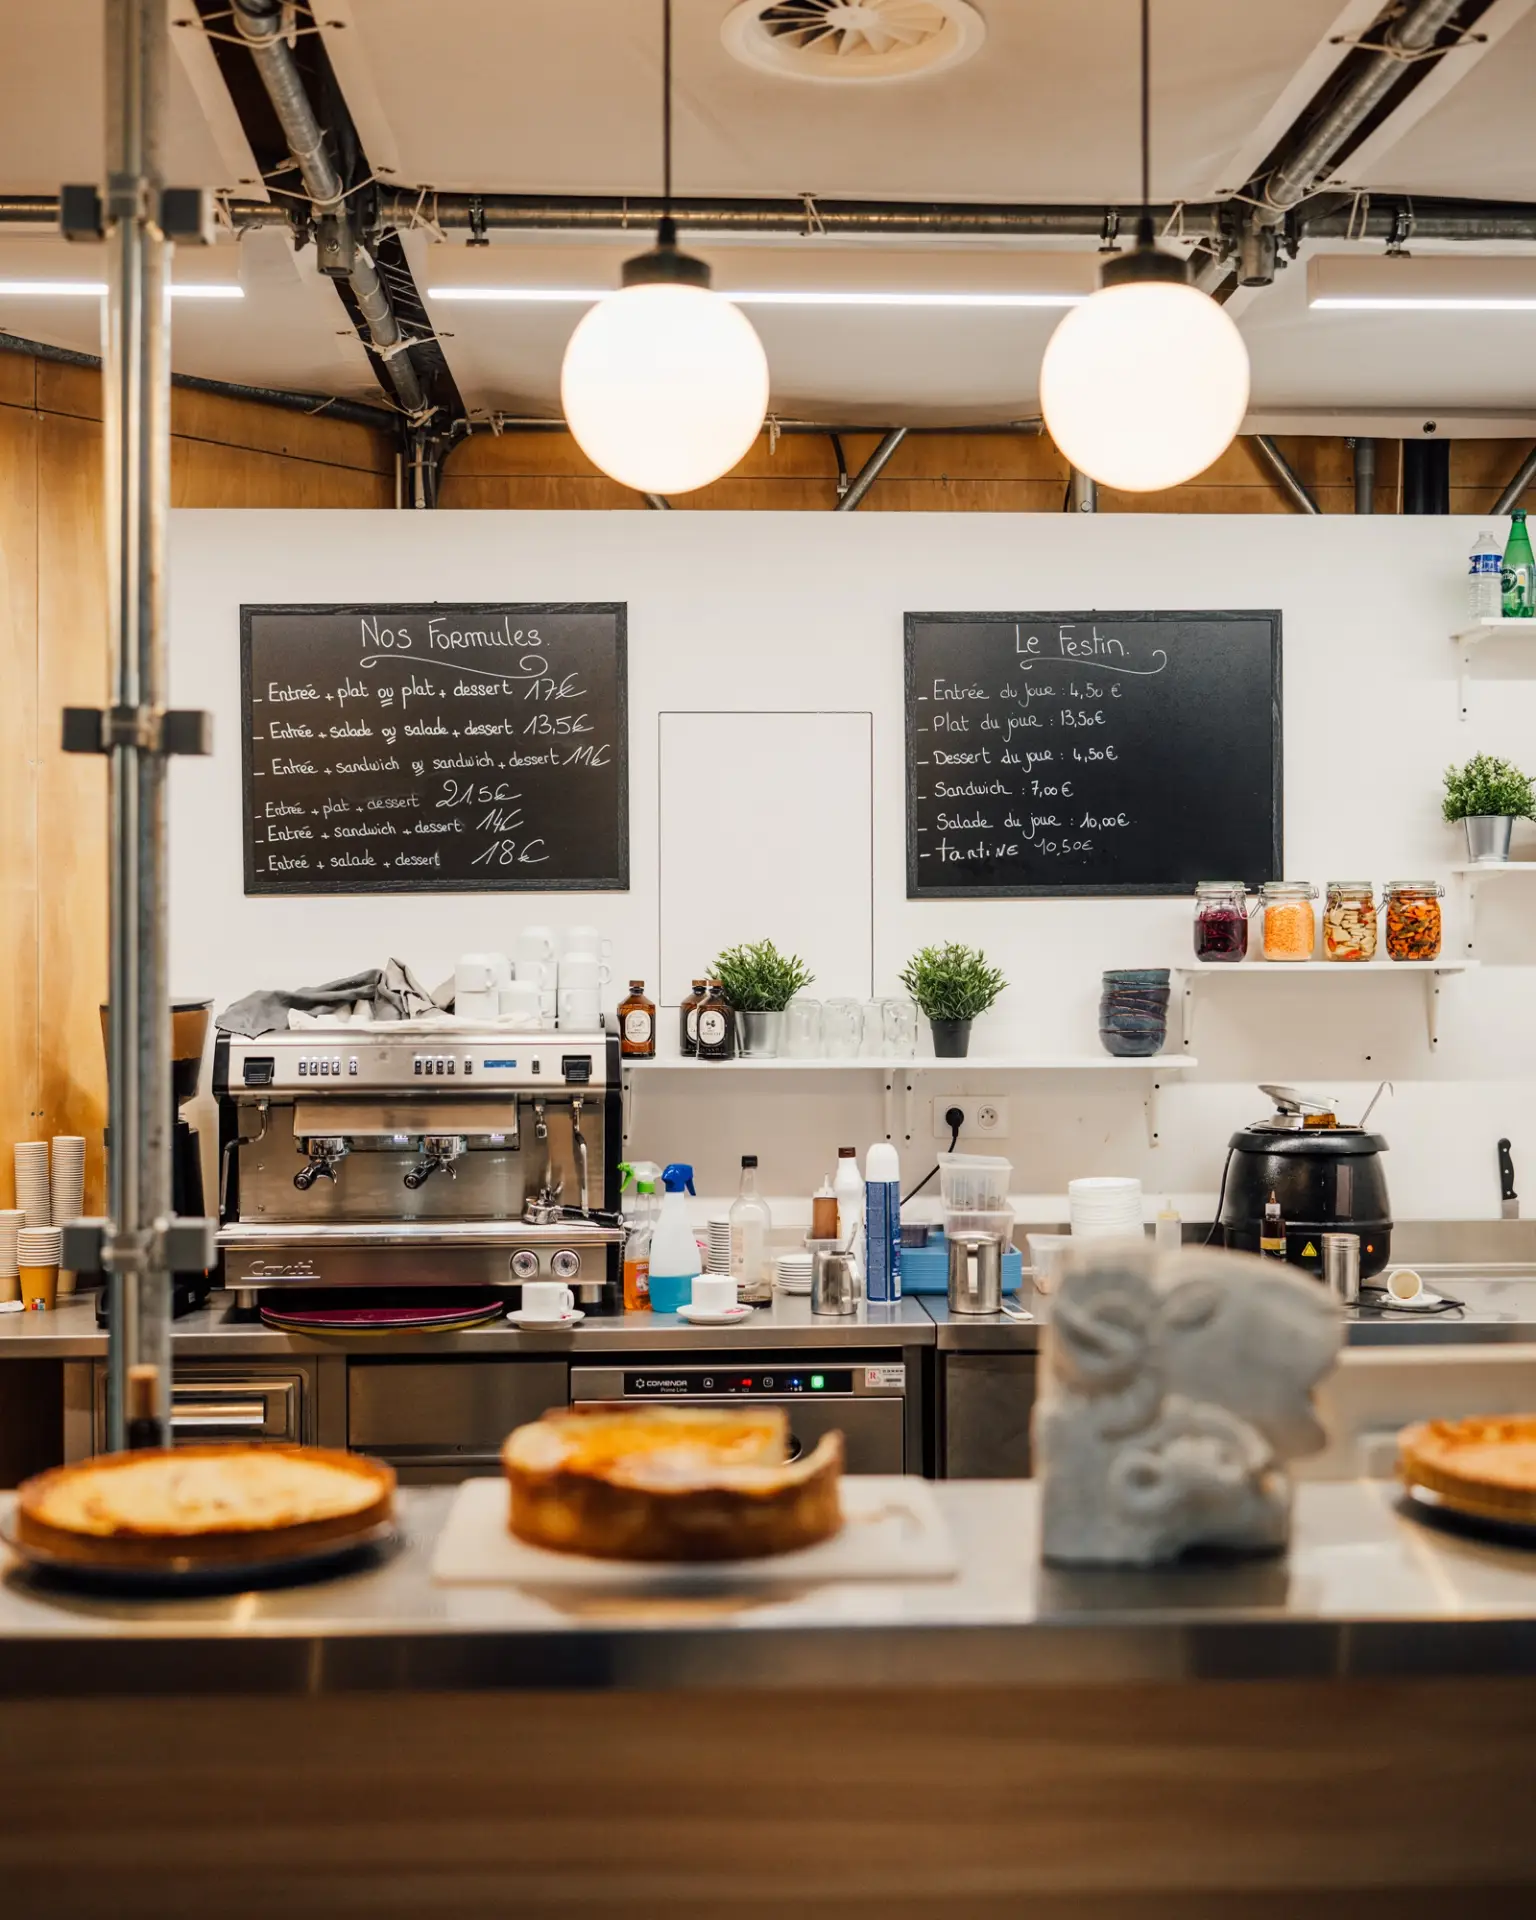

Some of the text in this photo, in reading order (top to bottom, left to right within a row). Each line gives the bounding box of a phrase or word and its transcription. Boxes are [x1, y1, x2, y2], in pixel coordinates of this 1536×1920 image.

[361, 618, 412, 650] Nos
[1014, 624, 1041, 654] Le
[337, 676, 368, 708] plat
[402, 675, 436, 709] plat
[454, 675, 513, 697] dessert
[524, 673, 587, 701] 17€
[933, 679, 990, 700] Entrée
[270, 722, 314, 740] Entrée
[329, 719, 373, 738] salade
[404, 717, 448, 737] salade
[464, 720, 513, 737] dessert
[523, 714, 595, 735] 13,5€
[933, 711, 969, 732] Plat
[981, 713, 1001, 729] du
[1003, 713, 1043, 742] jour
[272, 758, 318, 775] Entrée
[336, 750, 400, 773] sandwich
[433, 748, 494, 771] sandwich
[509, 751, 559, 768] dessert
[562, 744, 611, 768] 11€
[934, 748, 991, 766] Dessert
[1001, 750, 1022, 765] du
[935, 781, 1013, 798] Sandwich
[323, 798, 350, 821] plat
[367, 794, 420, 812] dessert
[268, 825, 314, 843] Entrée
[333, 821, 397, 839] sandwich
[414, 817, 463, 834] dessert
[937, 812, 994, 831] Salade
[1004, 813, 1022, 828] du
[1023, 813, 1062, 840] jour
[1079, 813, 1130, 831] 10,00€
[268, 856, 309, 873] Entrée
[330, 849, 376, 867] salade
[395, 851, 440, 867] dessert
[471, 839, 550, 866] 18€
[1034, 840, 1094, 857] 10,50€
